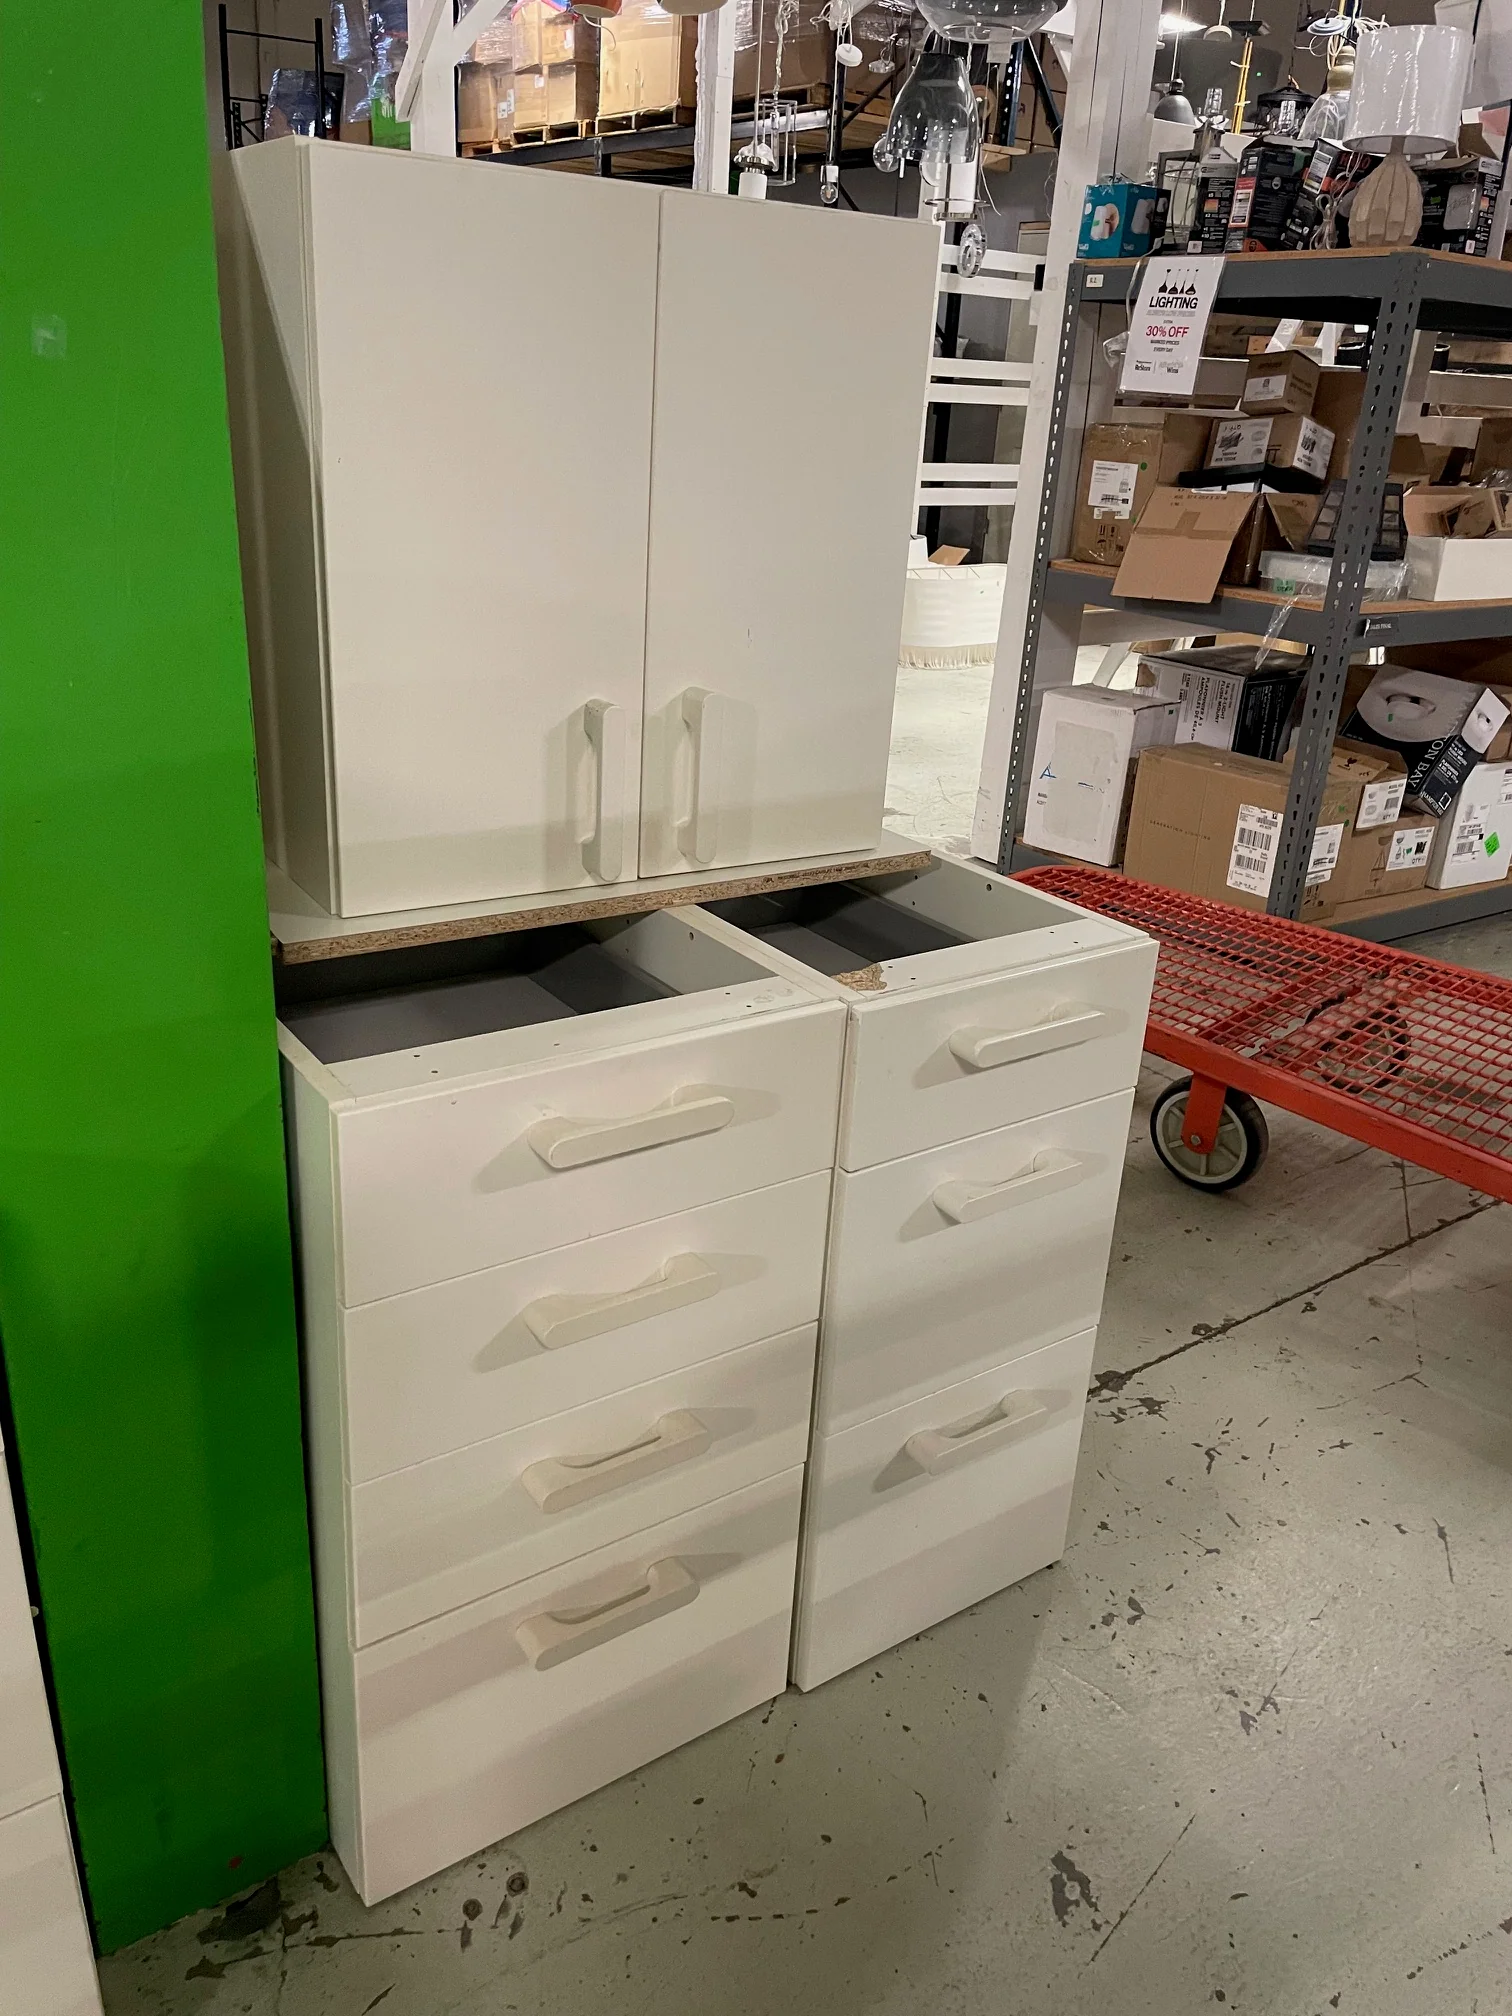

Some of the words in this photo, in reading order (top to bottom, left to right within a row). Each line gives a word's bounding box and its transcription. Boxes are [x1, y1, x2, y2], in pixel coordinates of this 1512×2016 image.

[1149, 296, 1199, 309] LIGHTING
[1145, 325, 1167, 337] 30%
[1168, 326, 1190, 337] OFF
[1408, 762, 1430, 788] BAY
